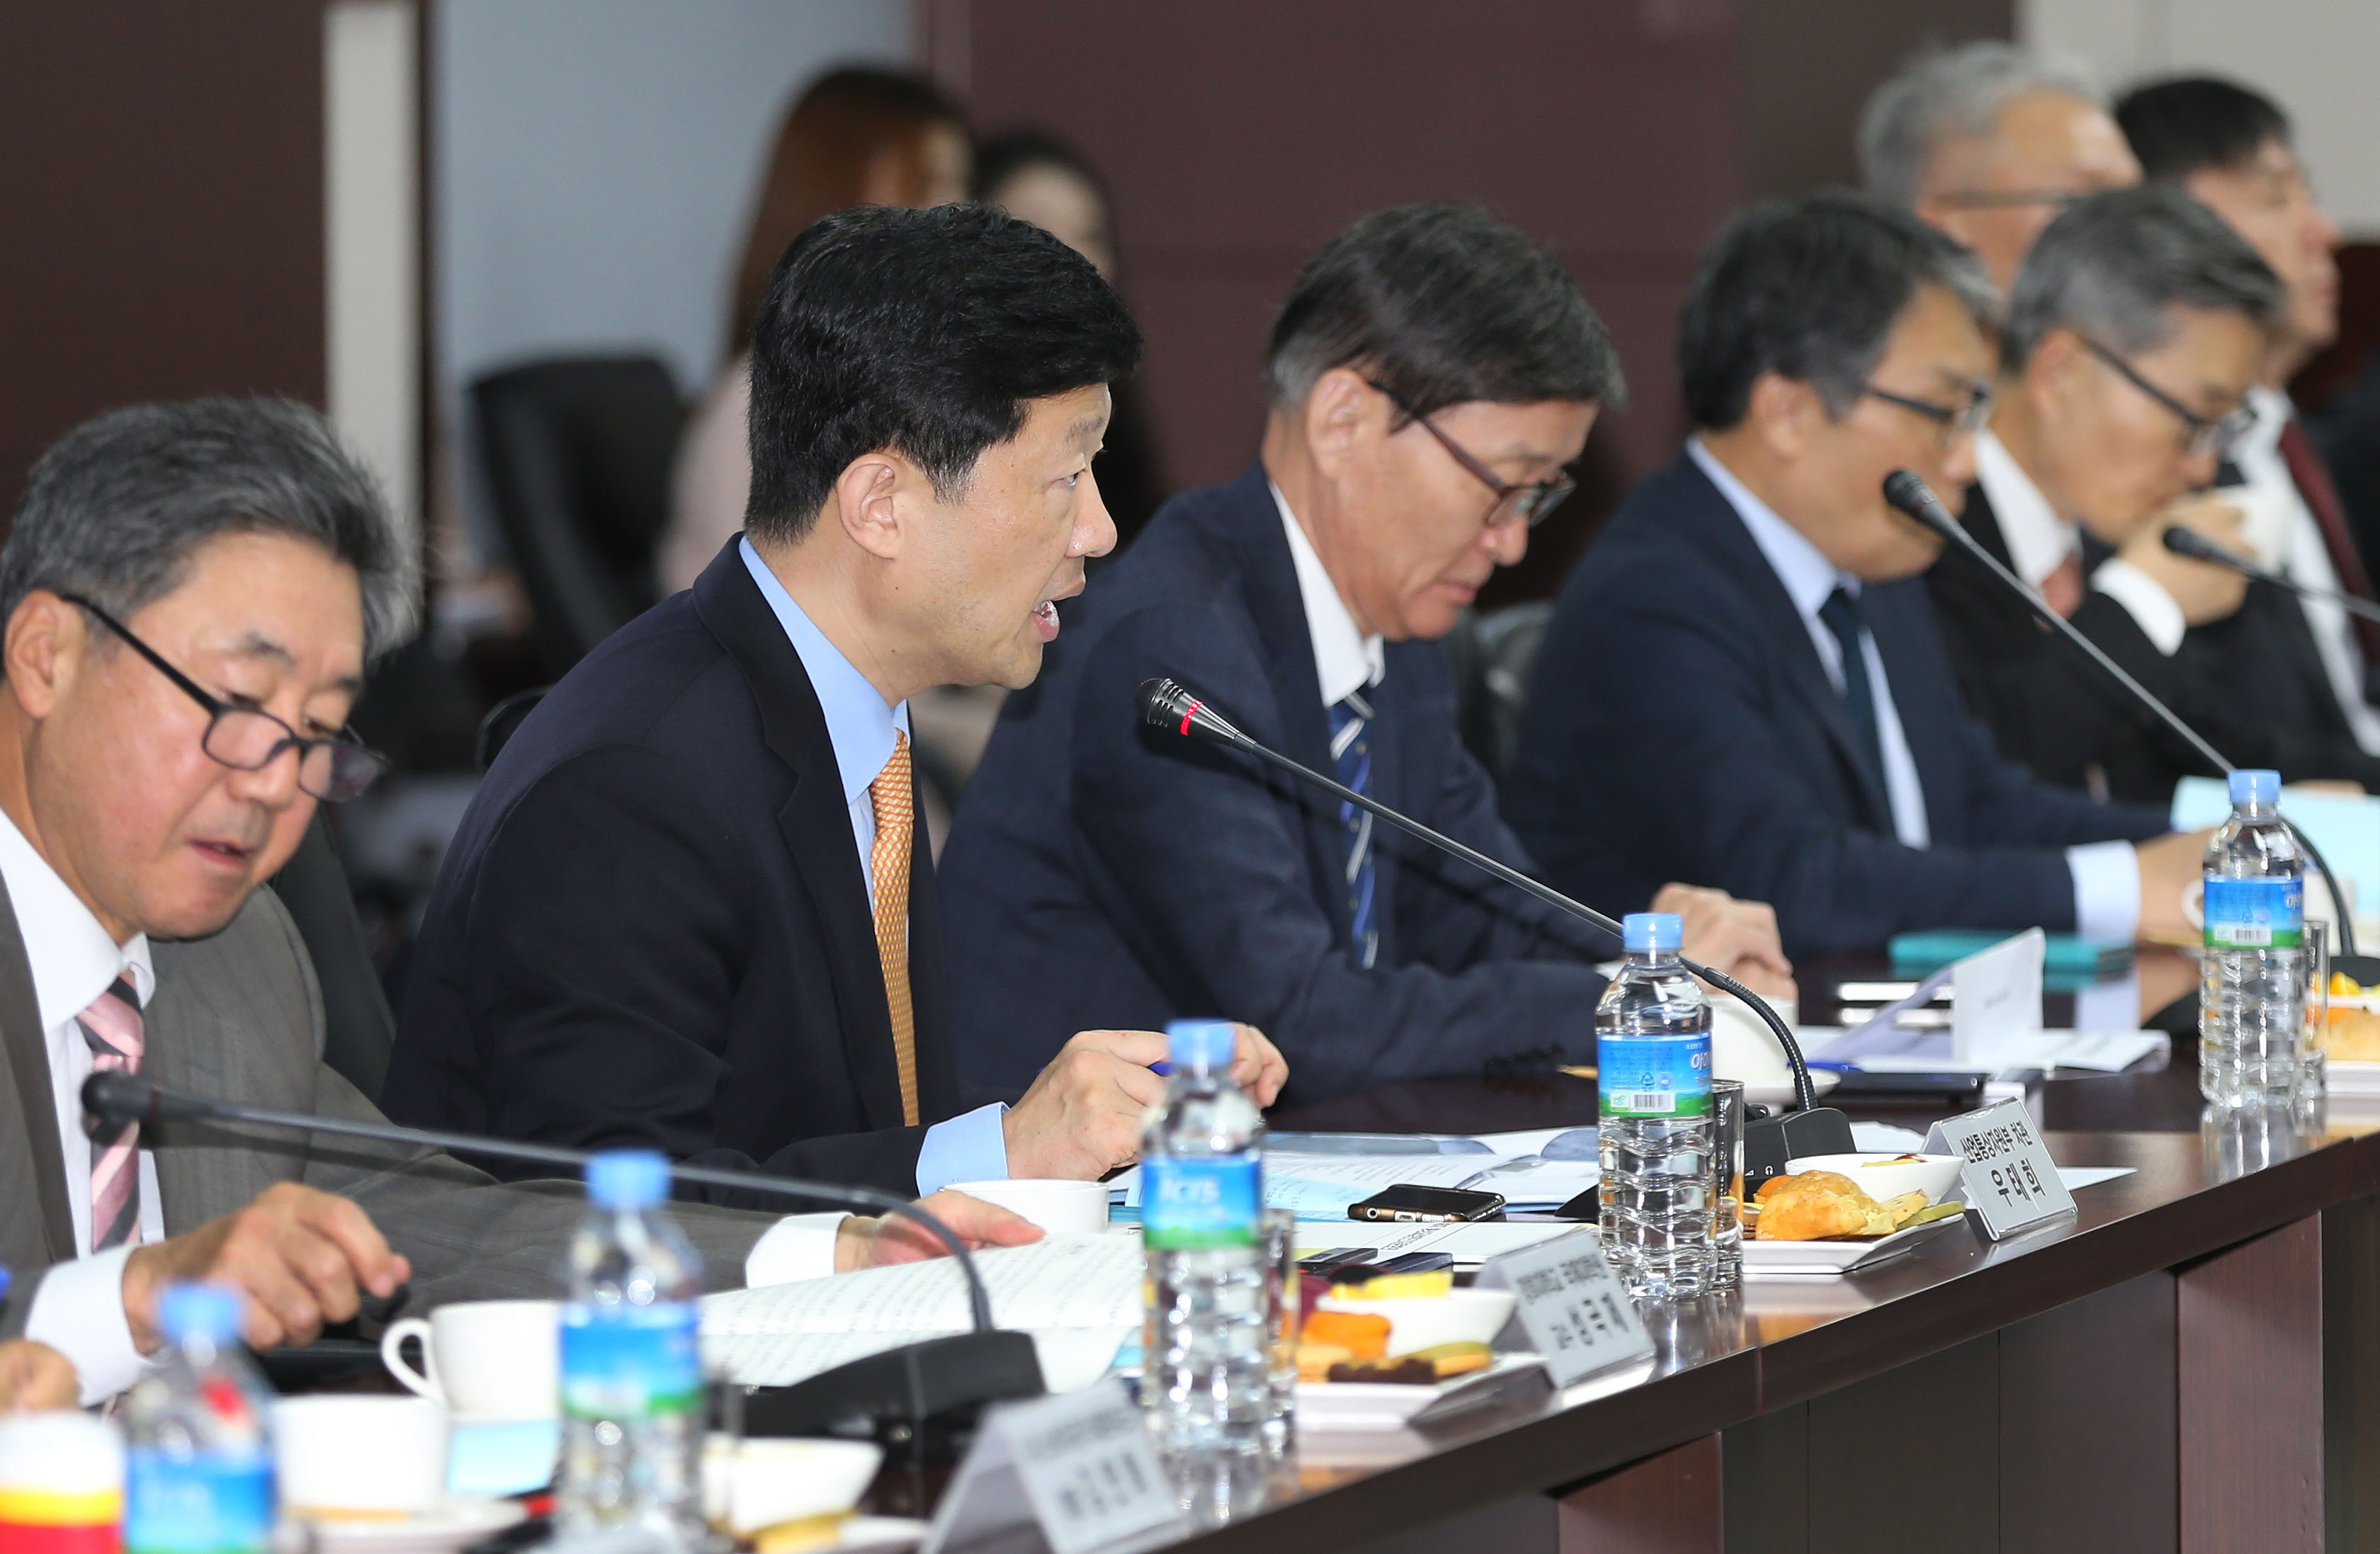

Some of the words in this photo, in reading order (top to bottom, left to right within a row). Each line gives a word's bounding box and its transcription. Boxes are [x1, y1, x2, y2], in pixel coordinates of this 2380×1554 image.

[1960, 1128, 2015, 1164] 산업통상자원부
[2010, 1120, 2034, 1147] 차관
[1990, 1157, 2046, 1208] 우태희
